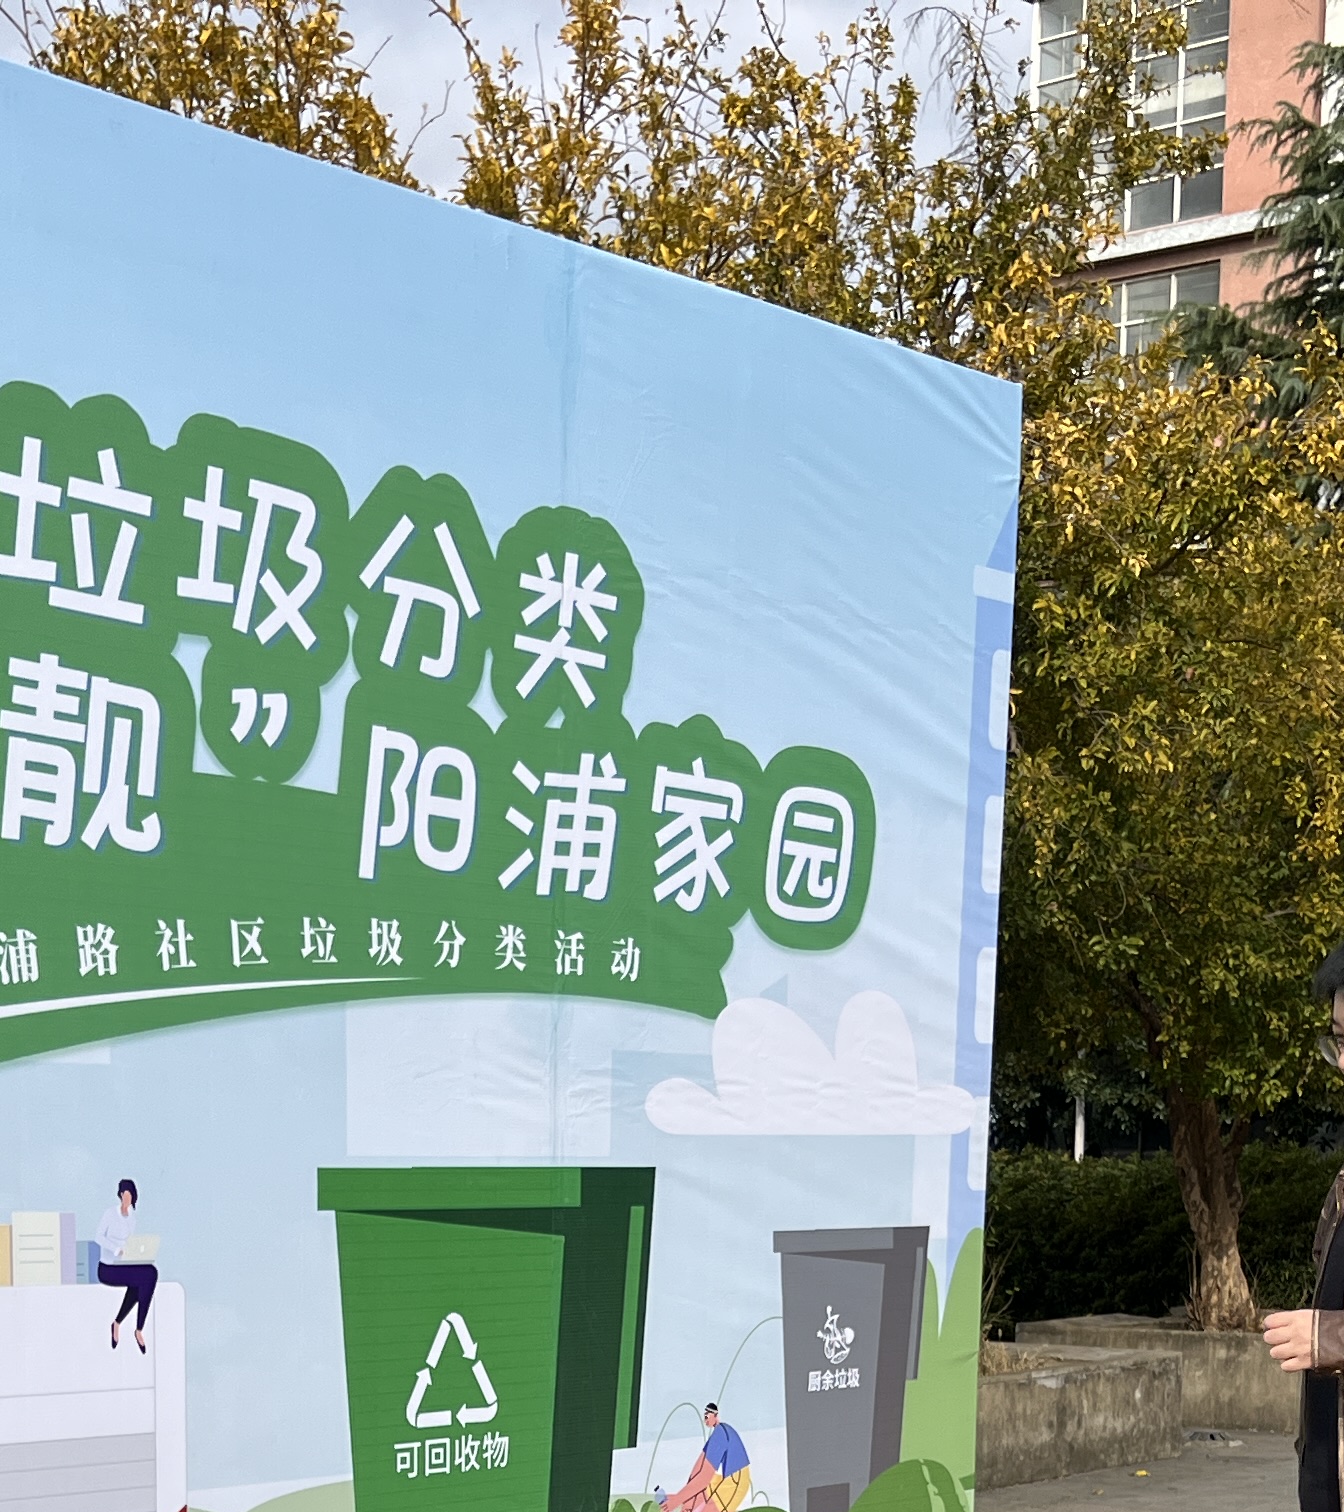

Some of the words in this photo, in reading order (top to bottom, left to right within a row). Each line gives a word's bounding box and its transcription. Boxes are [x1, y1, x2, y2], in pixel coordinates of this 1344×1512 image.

[807, 1367, 861, 1393] 厨余垃圾
[393, 1431, 510, 1479] 可回收物
